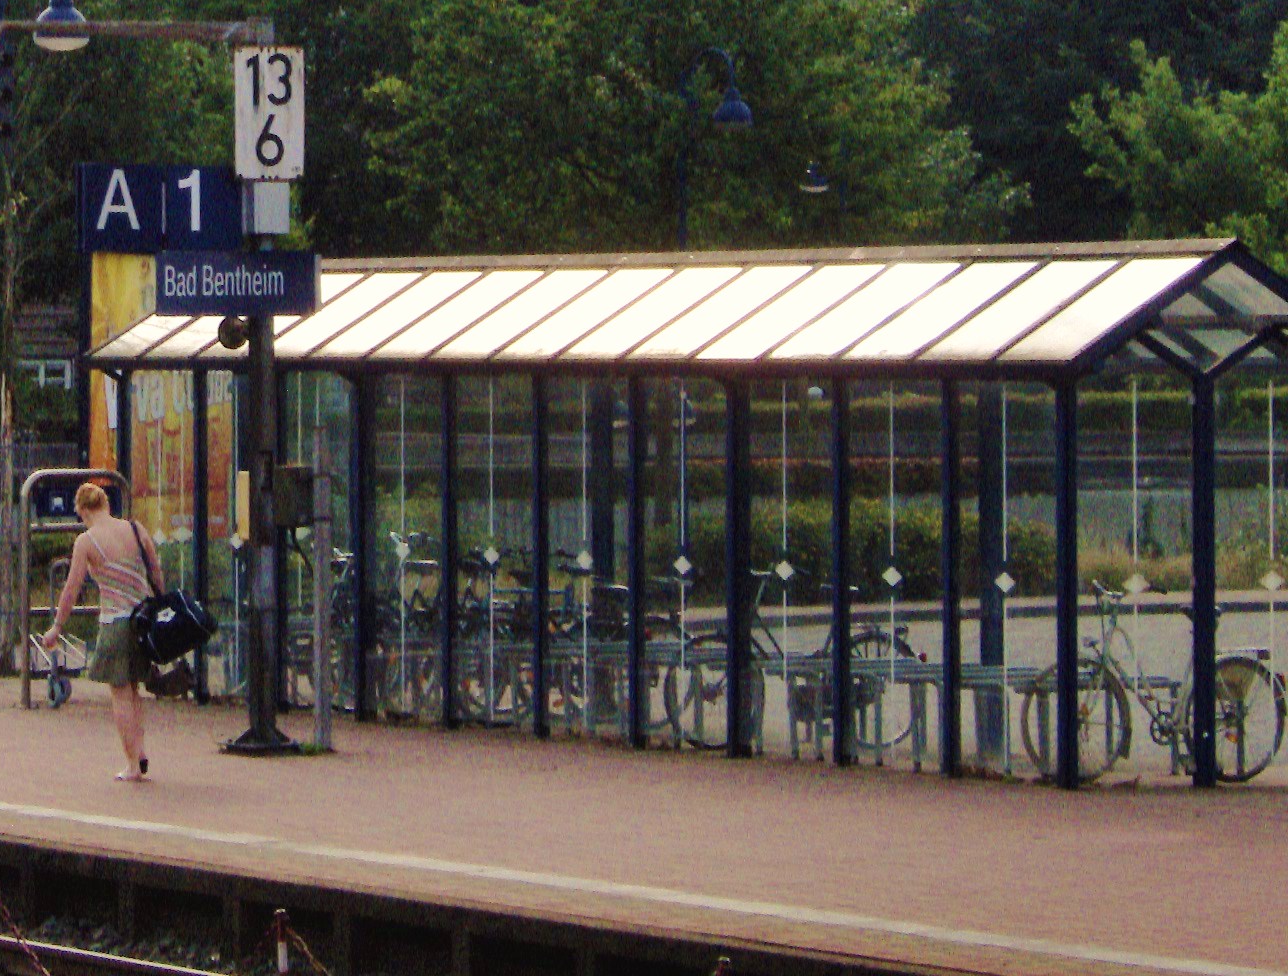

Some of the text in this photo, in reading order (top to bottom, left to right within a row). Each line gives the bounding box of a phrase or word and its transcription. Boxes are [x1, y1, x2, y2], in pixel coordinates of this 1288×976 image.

[246, 53, 292, 107] 13
[255, 113, 285, 167] 6
[96, 168, 201, 232] A 1
[164, 264, 285, 297] Bad Bentheim
